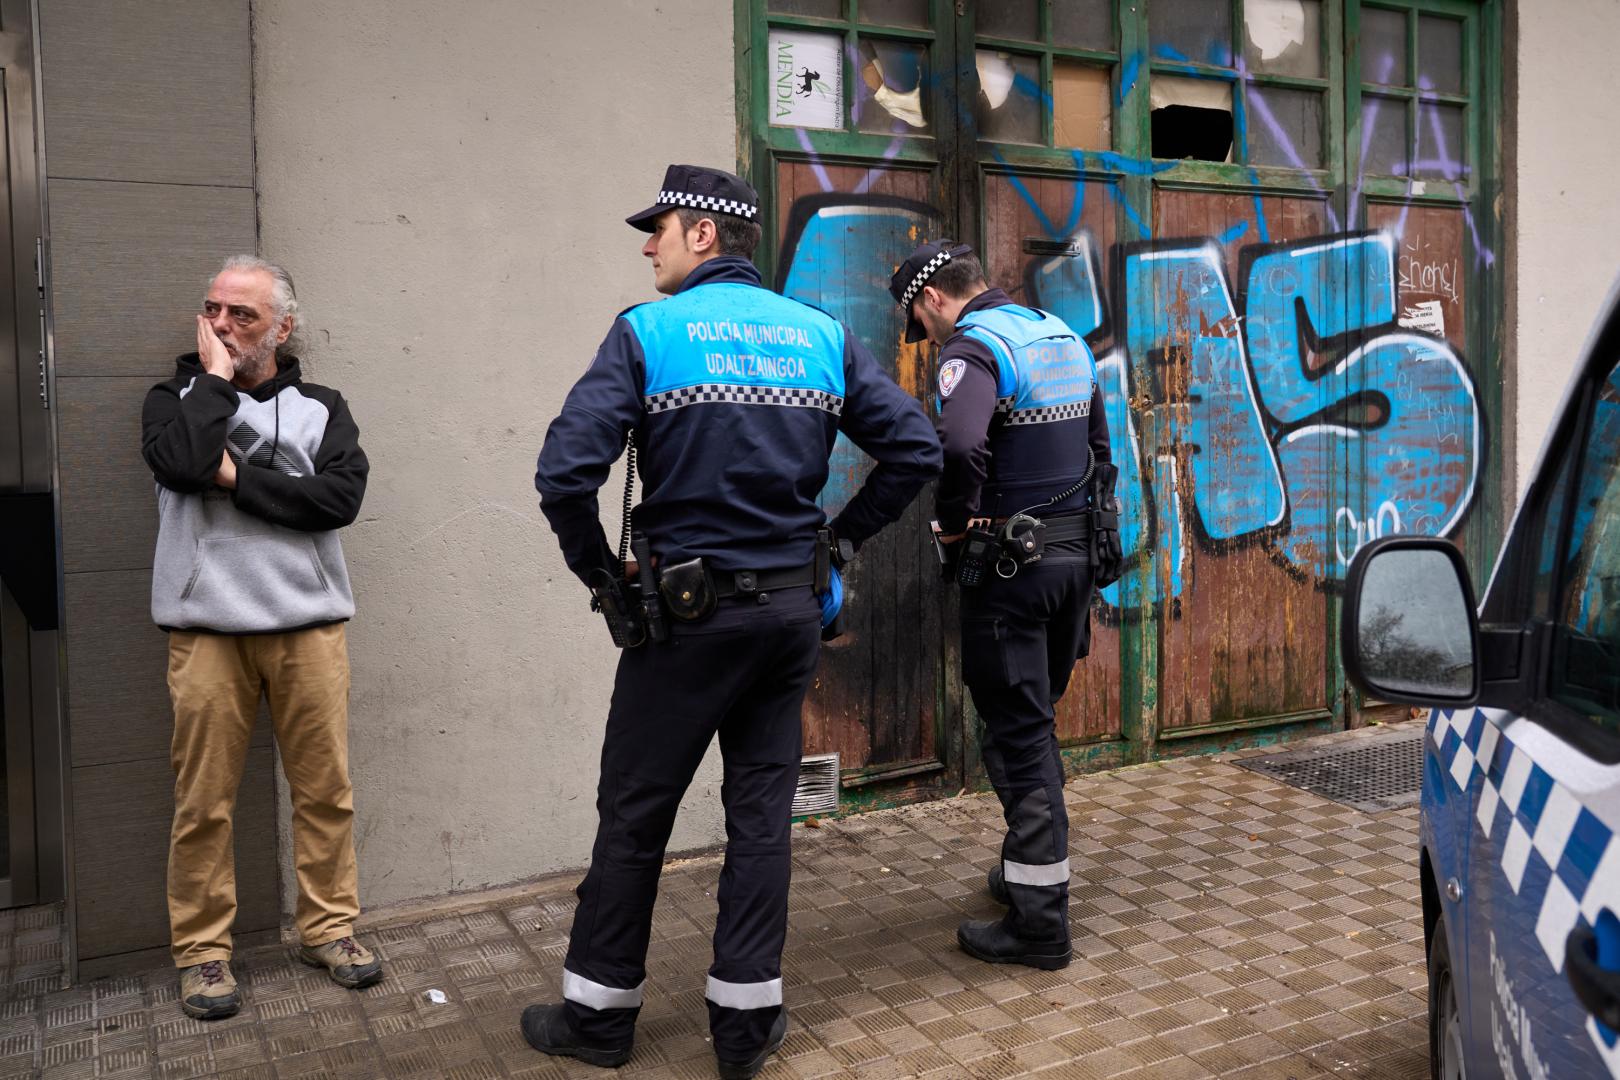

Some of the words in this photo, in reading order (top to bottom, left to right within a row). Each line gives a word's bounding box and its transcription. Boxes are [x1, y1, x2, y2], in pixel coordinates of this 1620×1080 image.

[776, 40, 796, 118] MENDÍA
[686, 318, 743, 343] POLICÍA
[743, 321, 813, 349] MUNICIPAL
[705, 353, 807, 379] UDALTZAINGOA
